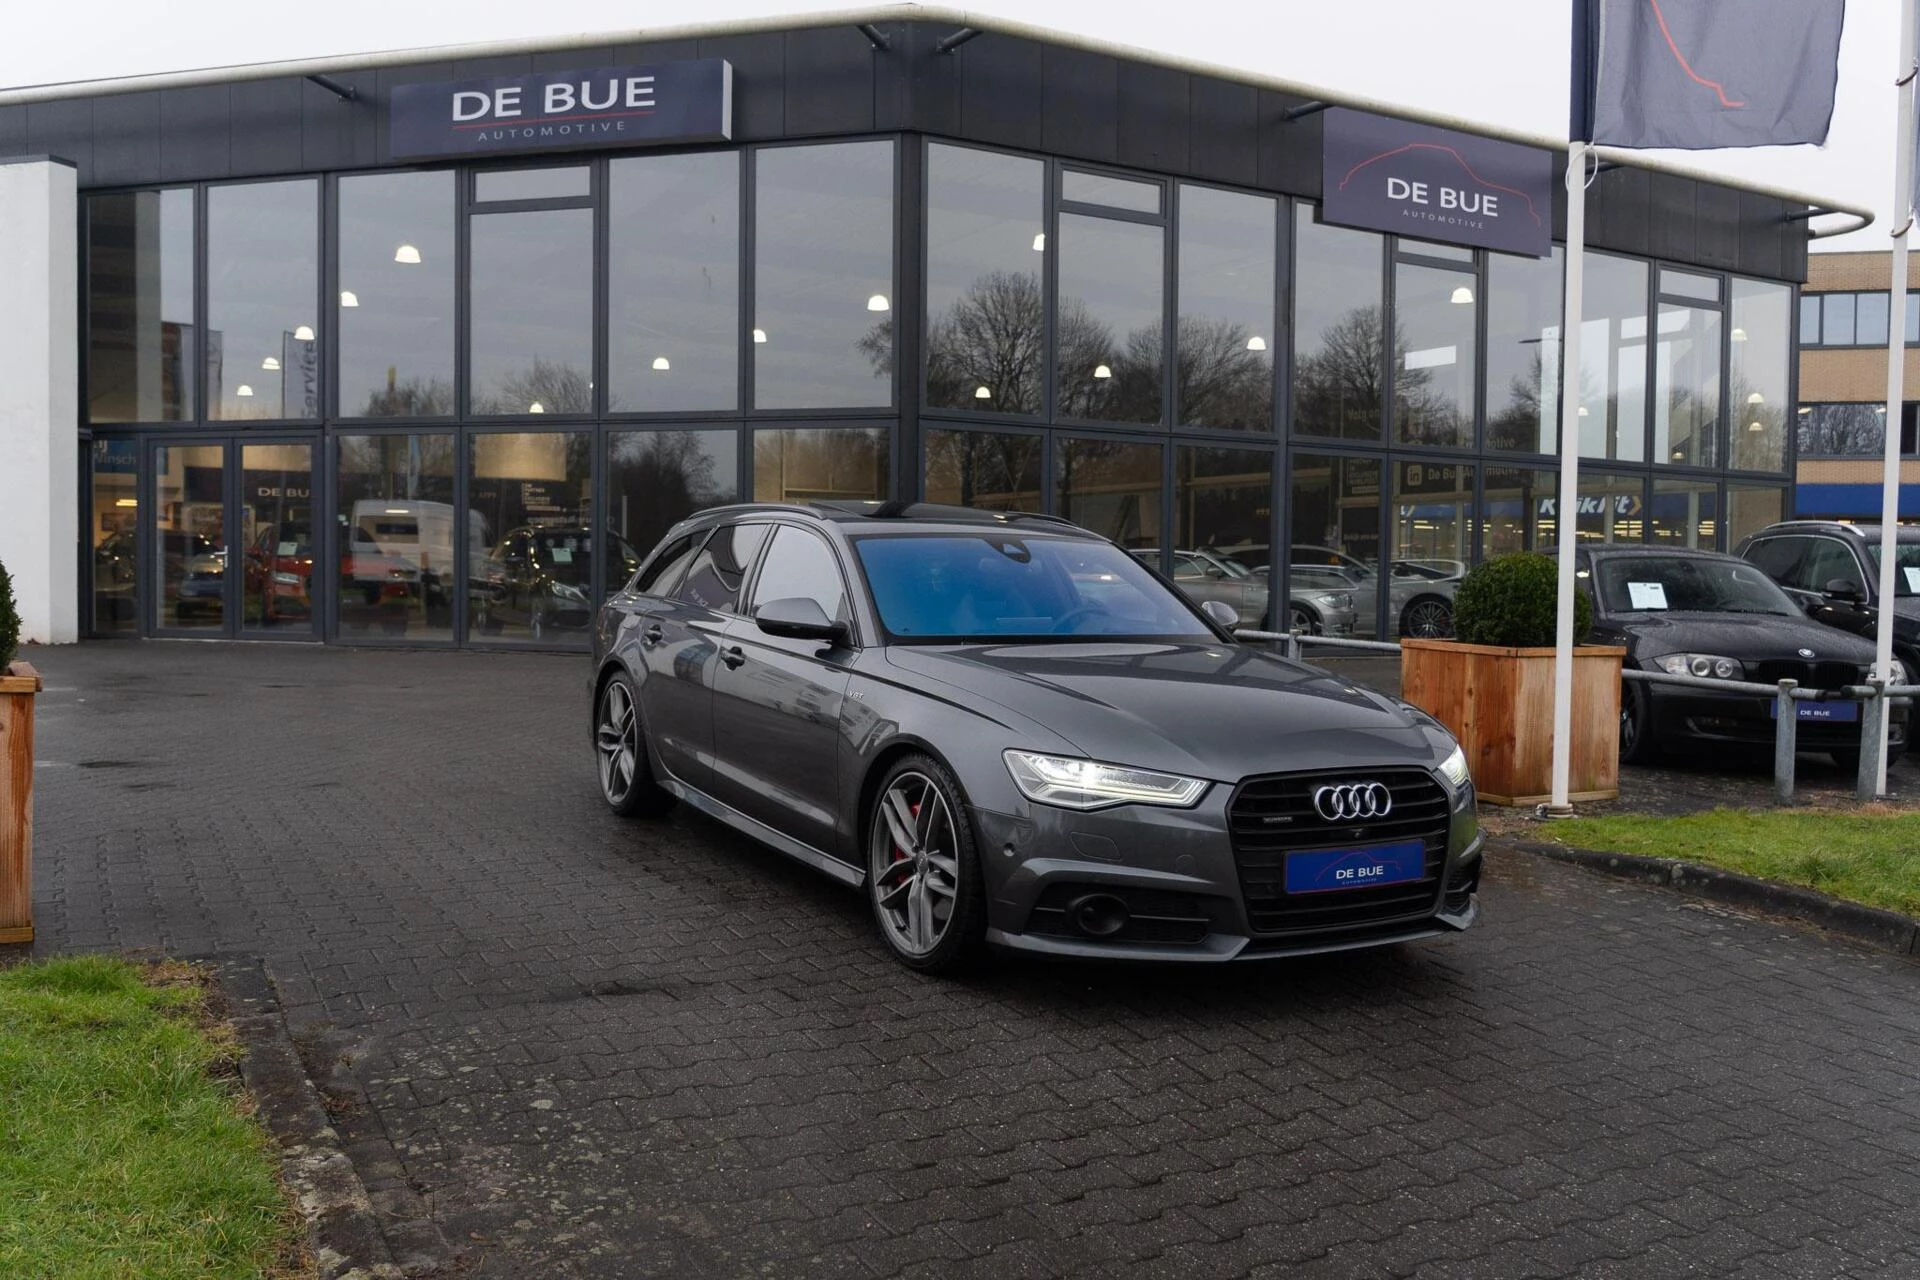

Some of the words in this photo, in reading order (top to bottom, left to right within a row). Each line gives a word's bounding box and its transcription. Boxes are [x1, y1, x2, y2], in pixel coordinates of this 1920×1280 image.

[452, 87, 522, 121] DE
[544, 76, 655, 113] BUE
[478, 121, 626, 142] AUTOMOTIVE
[1387, 177, 1429, 205] DE
[1440, 187, 1498, 217] BUE
[1402, 209, 1485, 229] AUTOMOTIVE
[258, 487, 281, 497] DE
[287, 488, 310, 498] BU
[1813, 709, 1830, 717] BUE
[1336, 868, 1354, 880] DE
[1358, 865, 1384, 877] BUE
